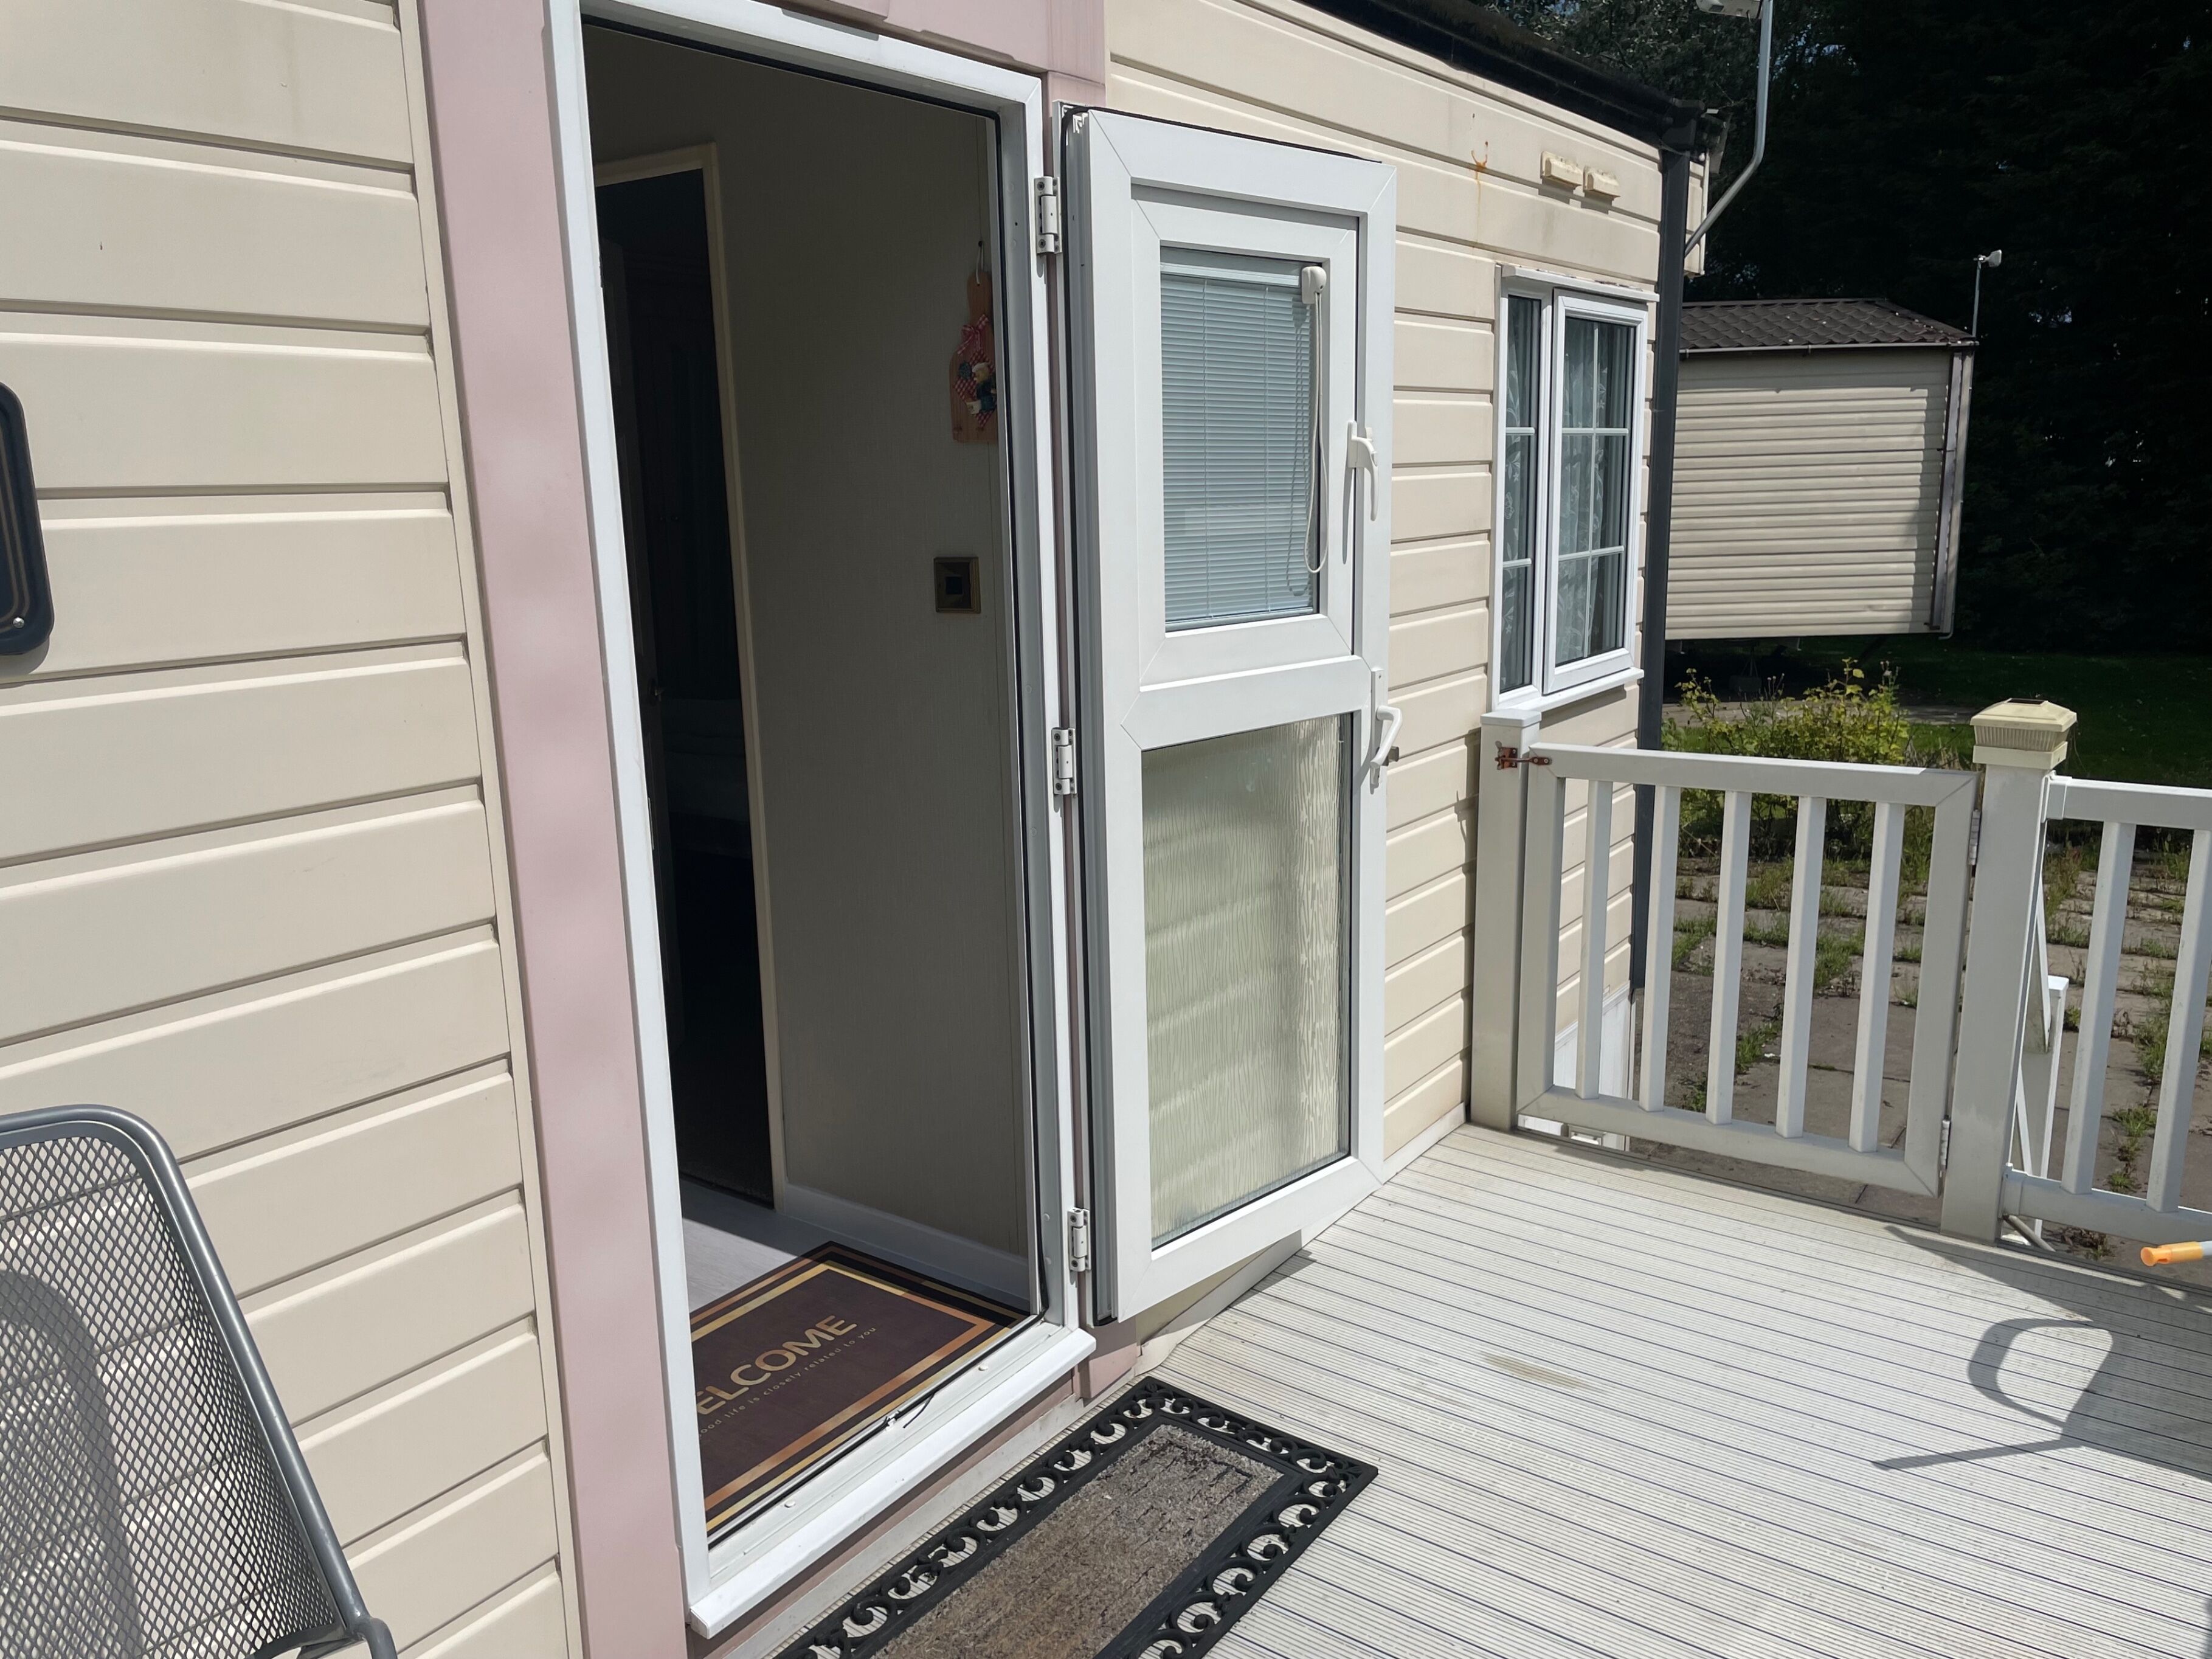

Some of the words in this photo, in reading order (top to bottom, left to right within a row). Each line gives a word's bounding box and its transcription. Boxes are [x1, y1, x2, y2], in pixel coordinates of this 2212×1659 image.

[696, 1315, 857, 1415] ELCOME
[699, 1419, 722, 1438] ood
[724, 1405, 746, 1418] life
[763, 1371, 801, 1396] closely
[804, 1348, 842, 1371] related
[858, 1327, 877, 1340] you
